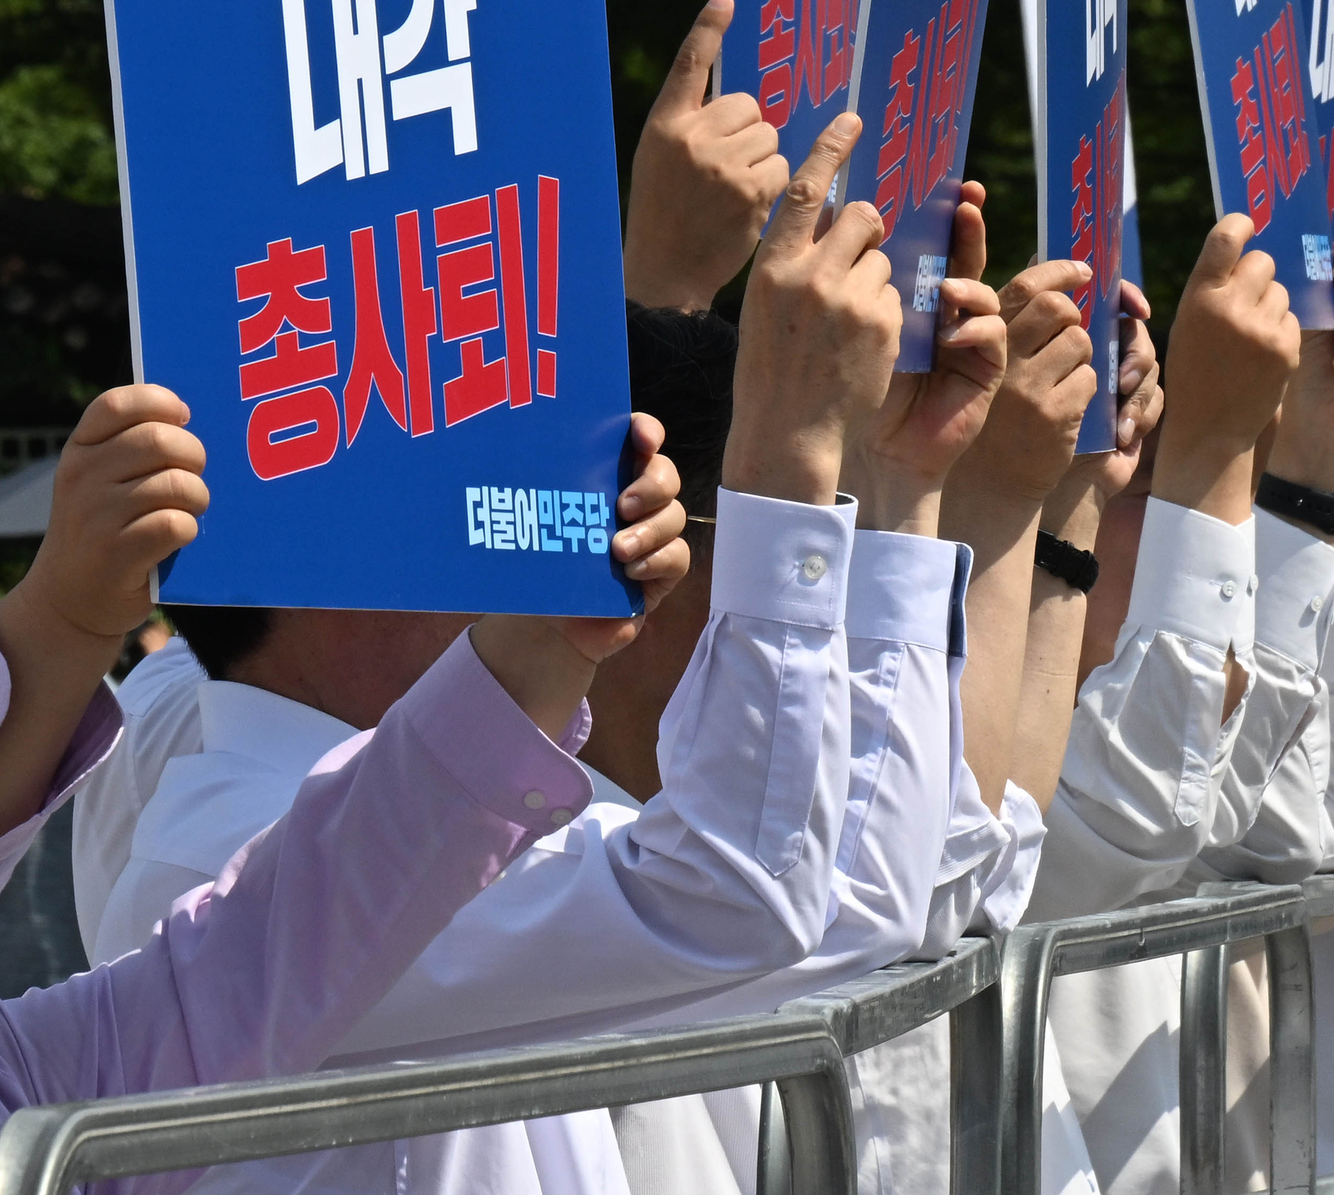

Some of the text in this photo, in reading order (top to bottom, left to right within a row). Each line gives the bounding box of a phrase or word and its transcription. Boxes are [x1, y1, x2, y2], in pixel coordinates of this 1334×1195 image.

[1230, 0, 1311, 238] 총사퇴!
[234, 174, 560, 482] 총사퇴!
[466, 485, 610, 555] 더불어민주당
